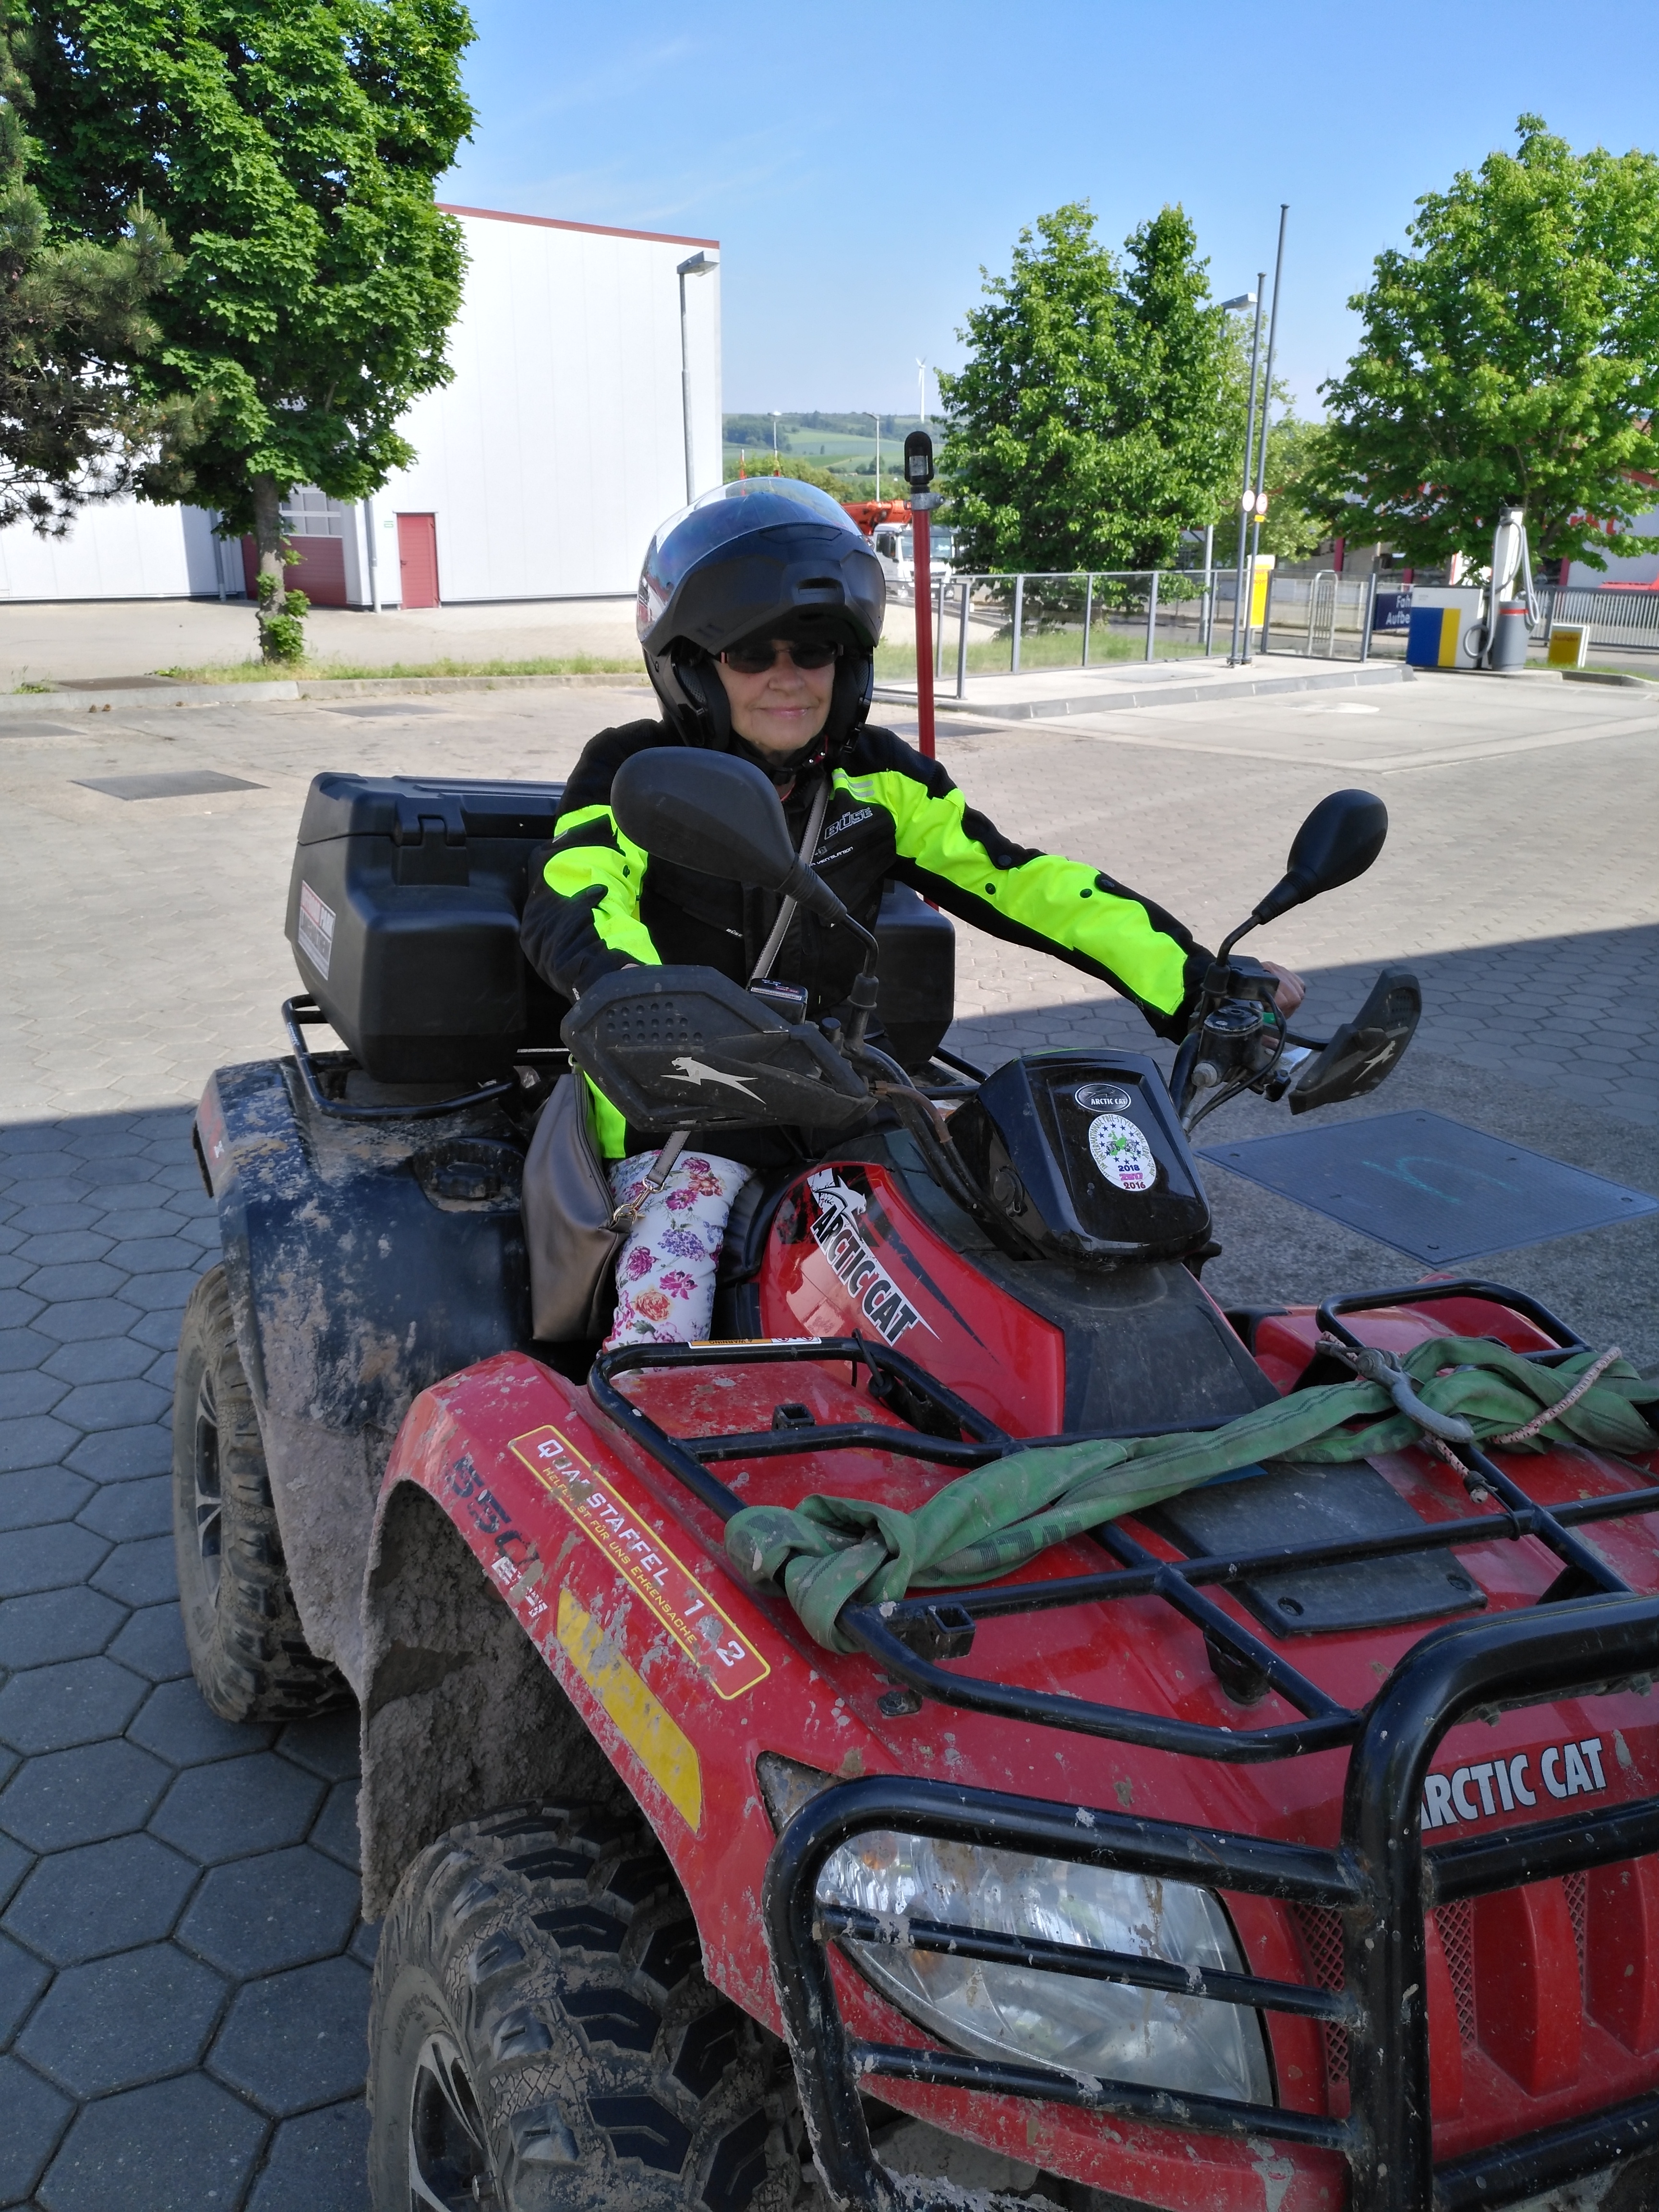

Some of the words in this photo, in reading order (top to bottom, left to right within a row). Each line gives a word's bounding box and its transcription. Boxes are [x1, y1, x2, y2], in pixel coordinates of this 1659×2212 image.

[824, 807, 873, 840] BÜSE
[1119, 1172, 1143, 1181] 2017
[810, 1204, 876, 1298] ARCTIC
[862, 1279, 917, 1346] CAT
[576, 1503, 592, 1518] ST
[590, 1520, 610, 1540] FÜR
[609, 1541, 631, 1564] UNS
[630, 1565, 697, 1643] EHRENSACHE
[1541, 1737, 1607, 1799] CAT
